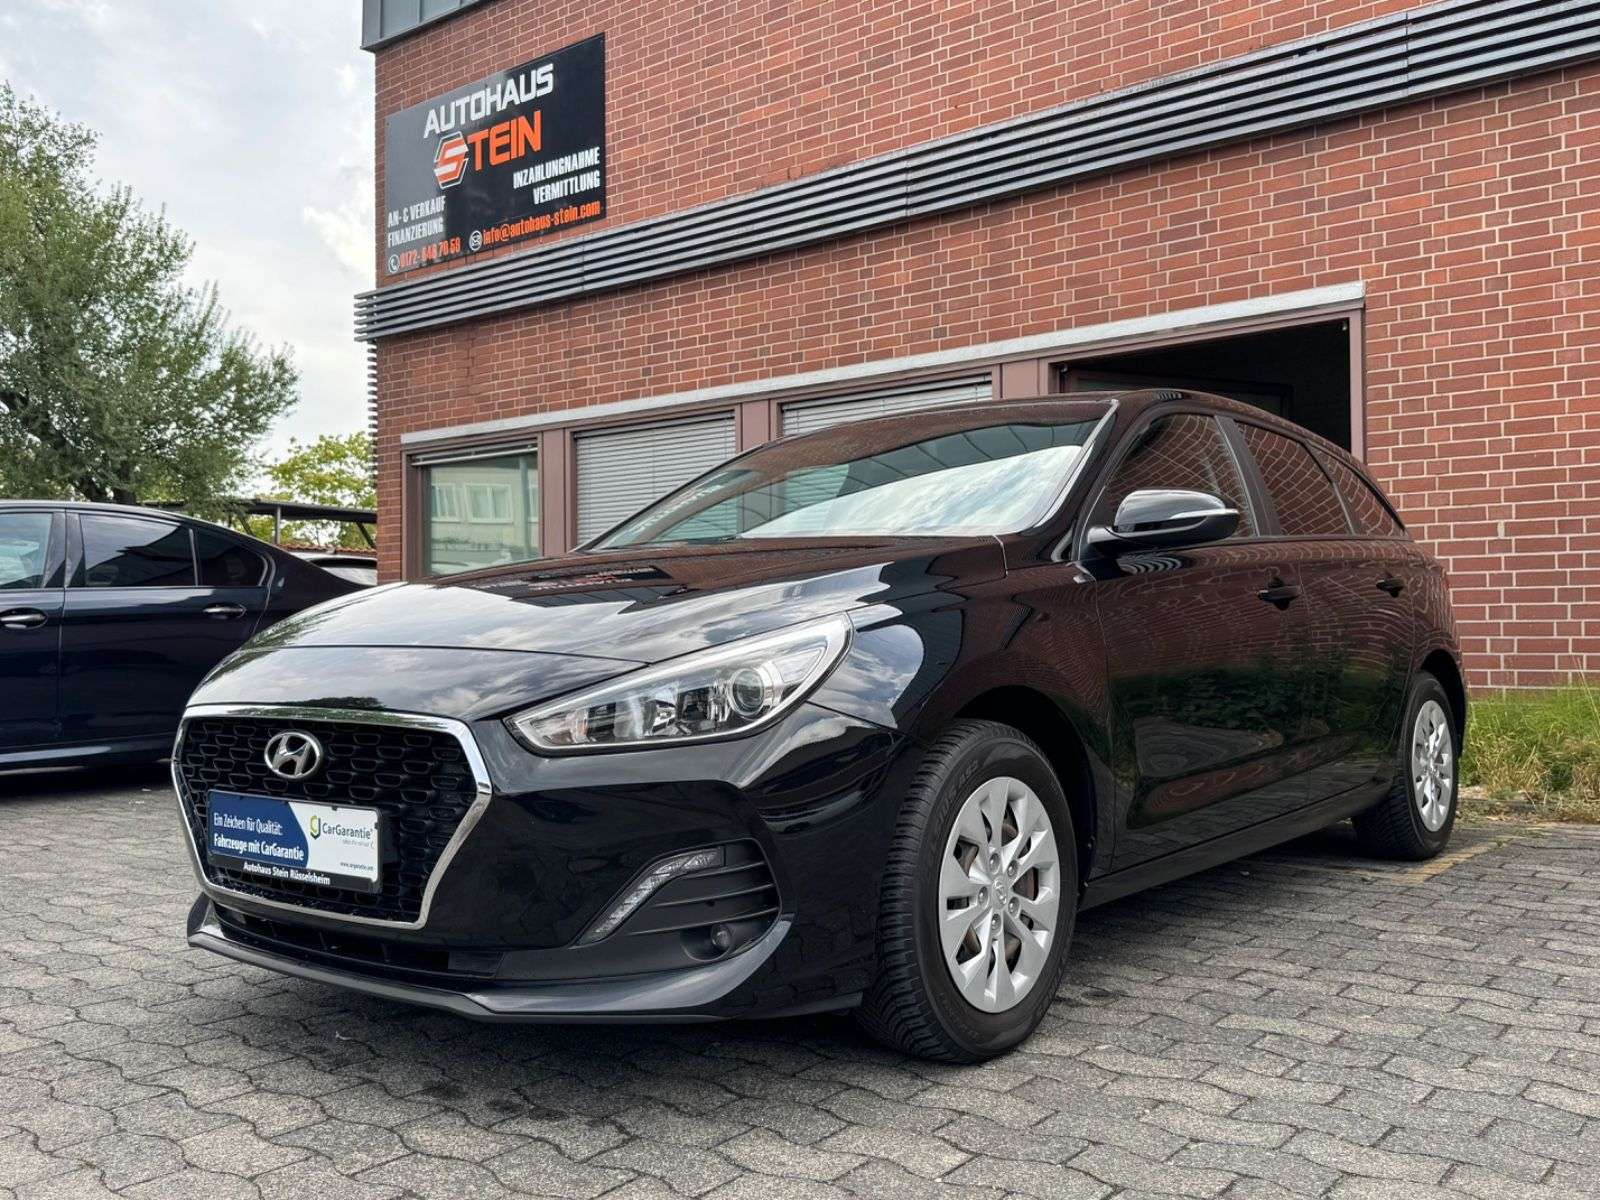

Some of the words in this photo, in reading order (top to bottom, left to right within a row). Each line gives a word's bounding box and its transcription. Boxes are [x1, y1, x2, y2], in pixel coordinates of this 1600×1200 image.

[423, 63, 554, 139] AUTOHAUS
[434, 110, 542, 188] STEIN
[513, 146, 600, 190] INZAHLUNGNAHME
[532, 170, 601, 205] VERMITTLUNG
[387, 209, 402, 228] AN-
[409, 195, 446, 221] VERKAUF
[483, 200, 601, 245] info@autohaus-stein.com
[387, 216, 444, 248] FINANZIERUNG
[213, 812, 223, 827] Ein
[223, 813, 247, 831] Zeichen
[246, 817, 255, 832] für
[213, 833, 247, 855] Fahrzeuge
[248, 839, 260, 854] mit
[261, 840, 305, 861] CarGarantie
[243, 861, 272, 875] Autohaus
[272, 866, 289, 878] Stein
[289, 869, 331, 885] Rüsselsheim
